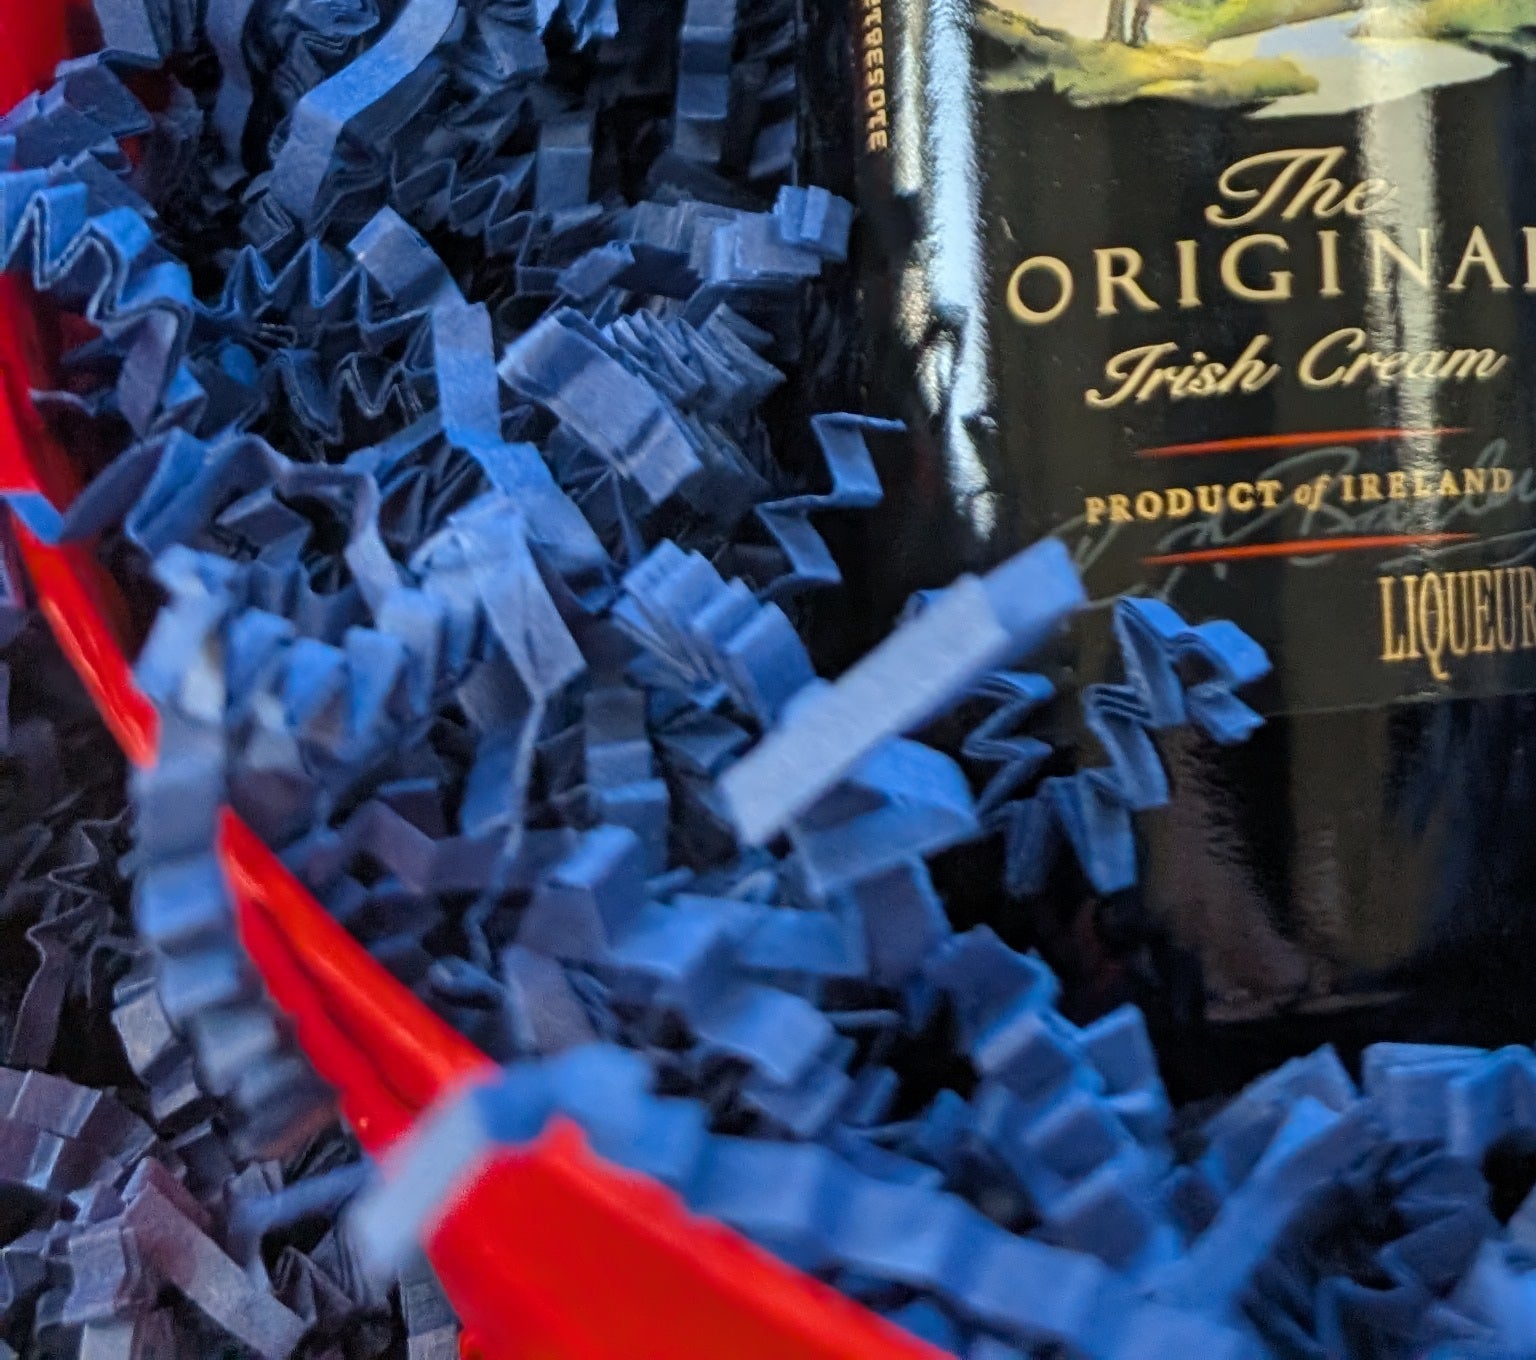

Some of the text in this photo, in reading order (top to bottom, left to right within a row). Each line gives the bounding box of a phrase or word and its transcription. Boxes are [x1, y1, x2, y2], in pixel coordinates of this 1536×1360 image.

[1204, 146, 1399, 228] The
[1085, 326, 1510, 409] Irish Cream
[1085, 466, 1515, 526] PRODUCT of IRELAND
